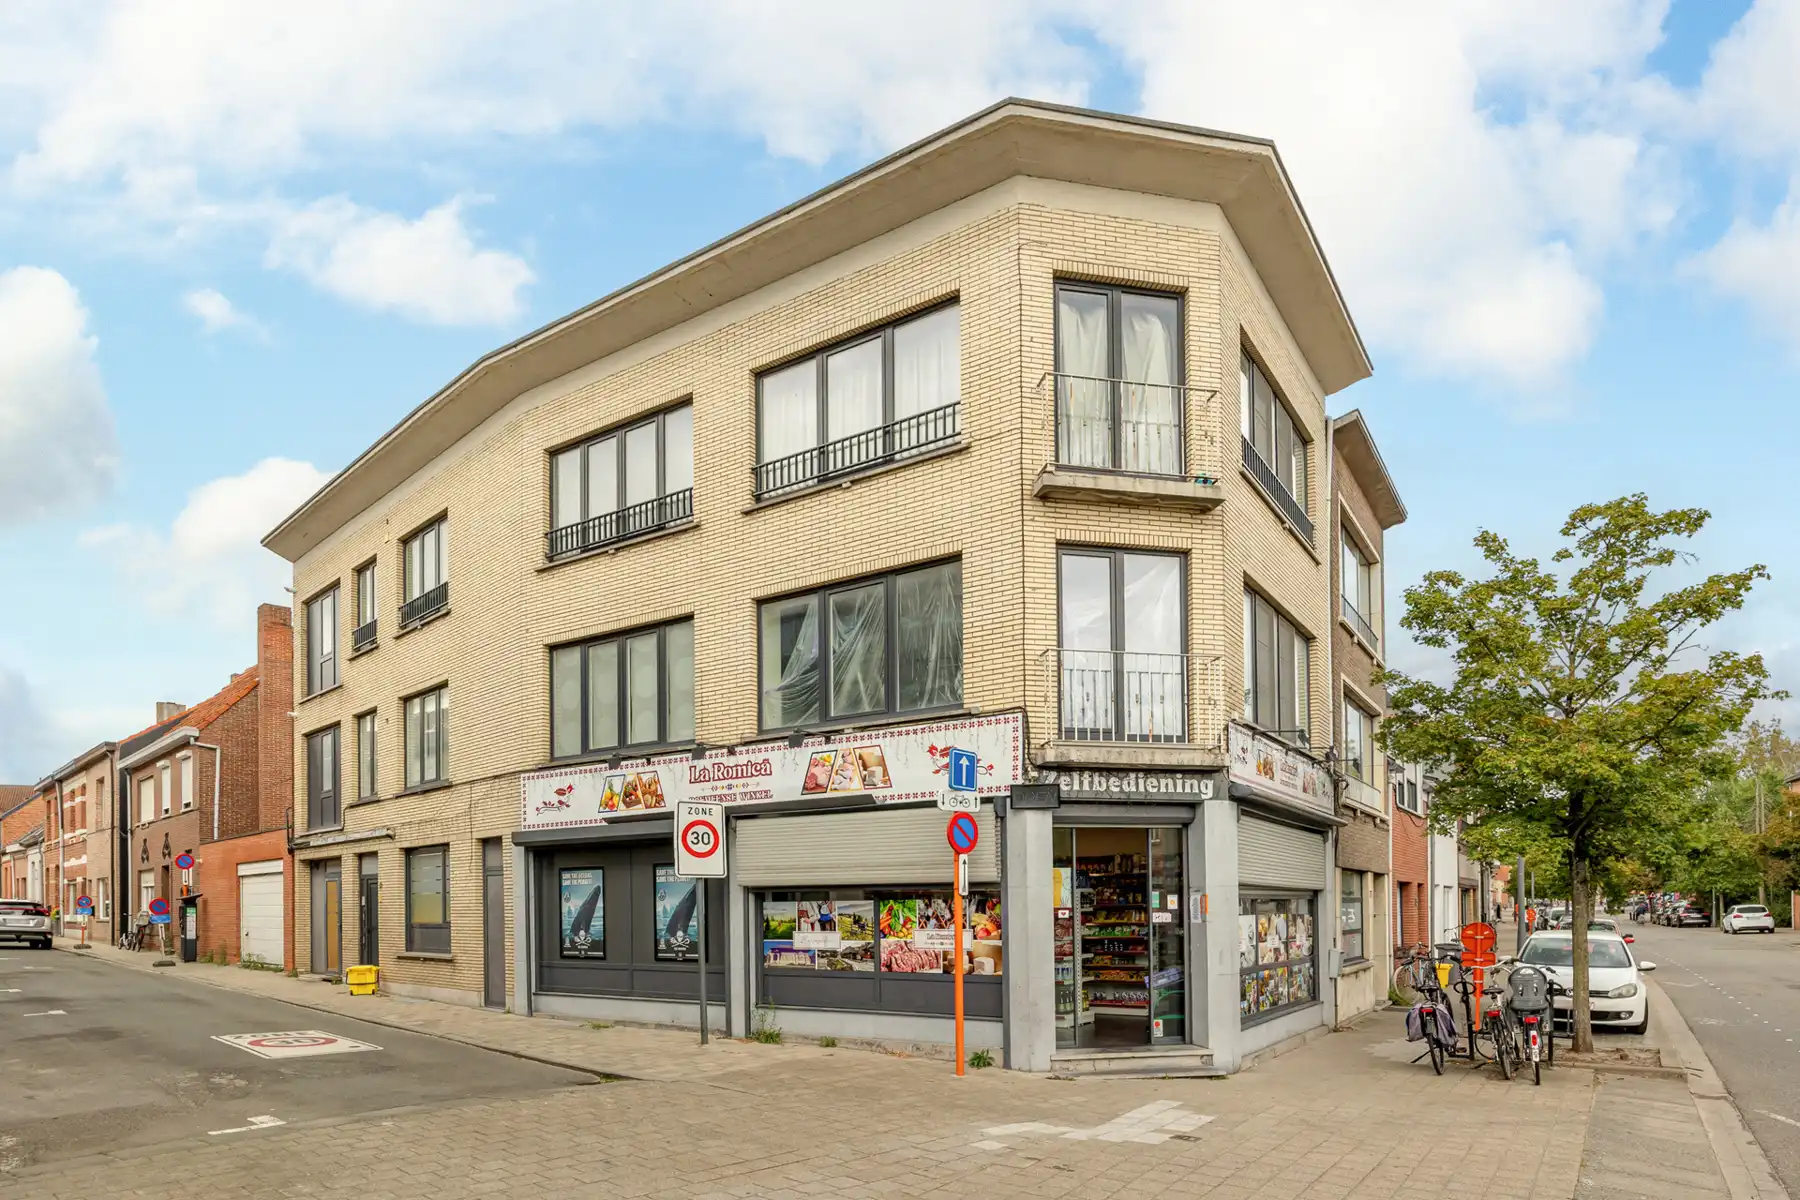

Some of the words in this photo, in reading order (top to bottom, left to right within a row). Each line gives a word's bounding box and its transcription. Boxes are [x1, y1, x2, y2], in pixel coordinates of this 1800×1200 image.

[689, 765, 711, 784] La
[1043, 769, 1214, 799] Zelfbediening
[687, 806, 714, 816] ZONE
[690, 831, 711, 846] 30
